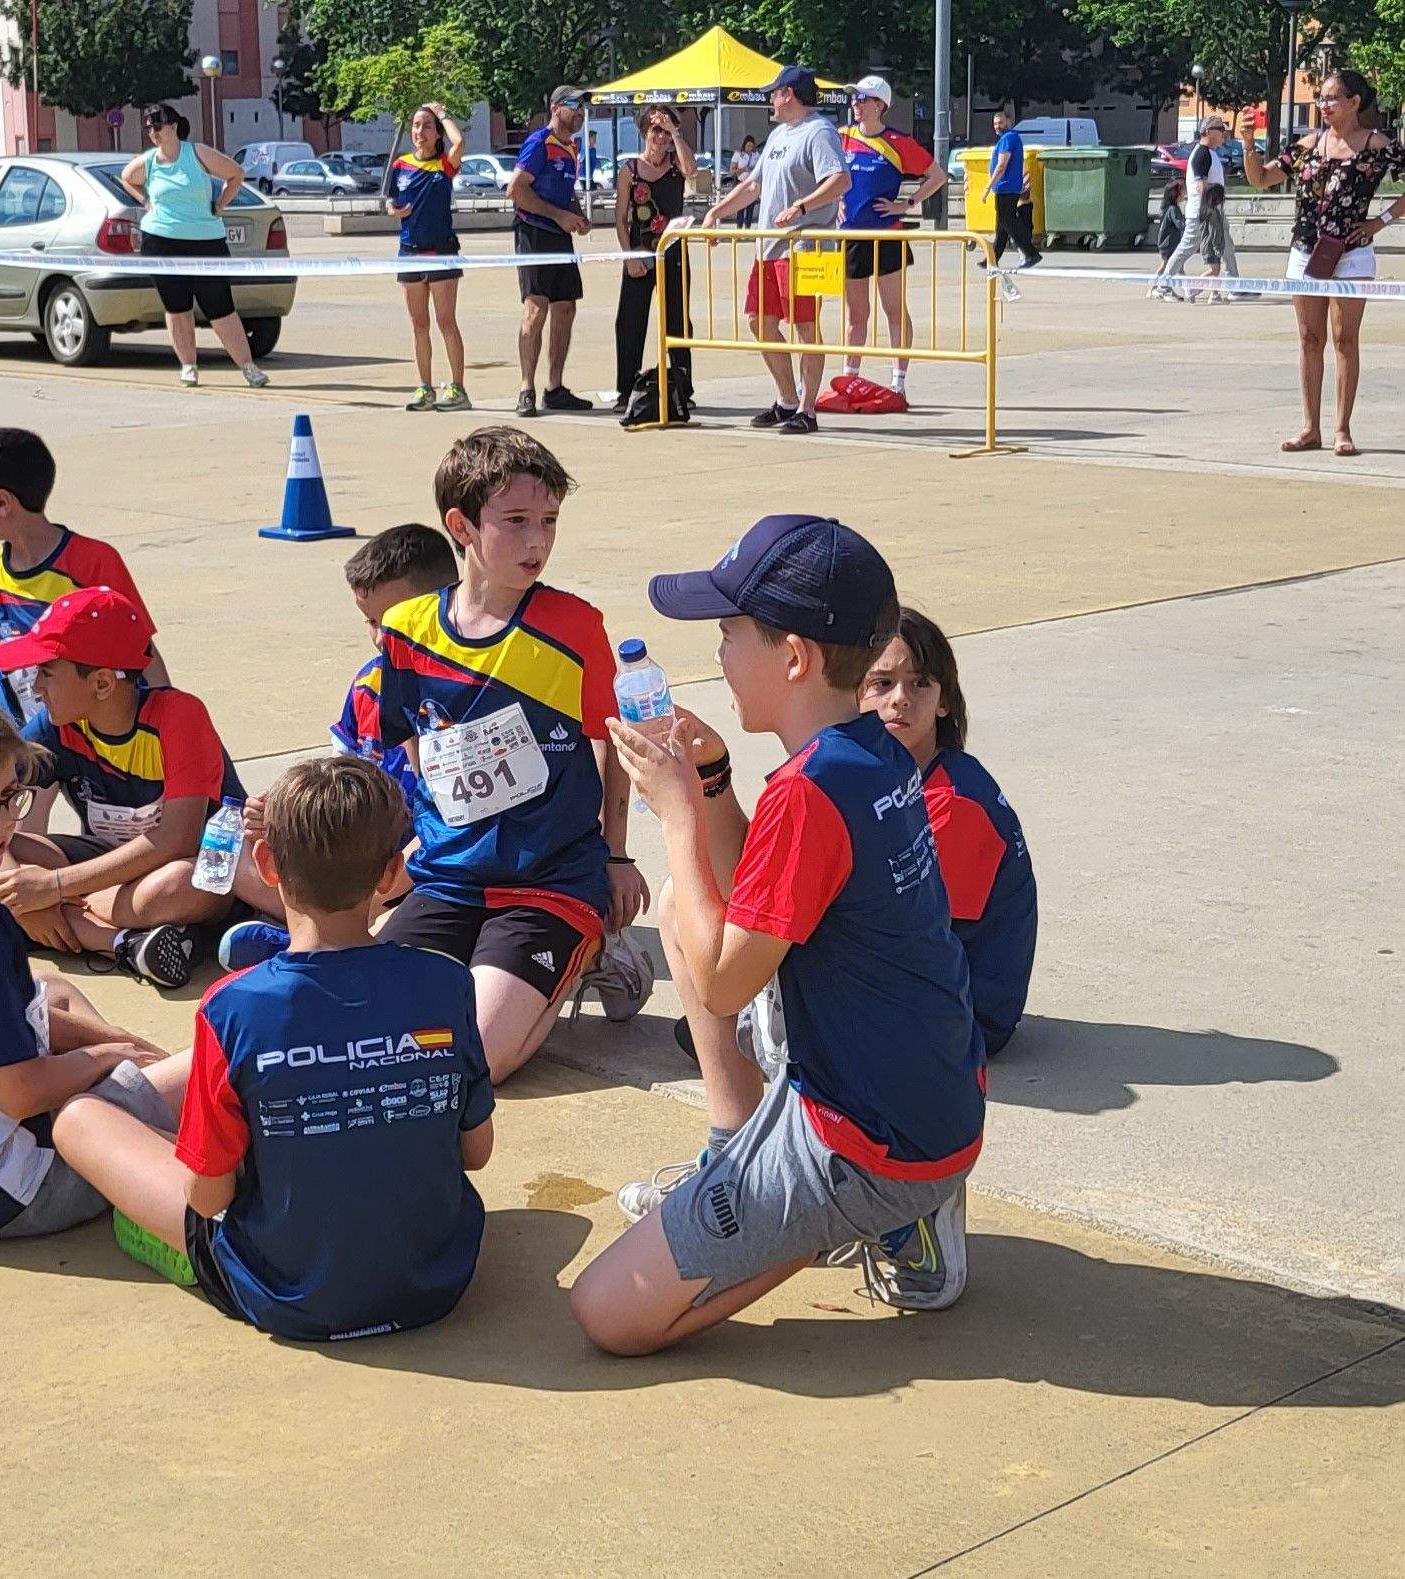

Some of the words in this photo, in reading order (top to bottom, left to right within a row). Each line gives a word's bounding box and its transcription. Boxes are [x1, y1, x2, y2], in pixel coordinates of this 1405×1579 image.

[633, 92, 672, 105] embou
[676, 91, 716, 104] embou
[727, 90, 767, 103] embou
[451, 758, 518, 804] 491
[349, 1048, 455, 1071] NACIONAL
[708, 1182, 740, 1240] PUMA
